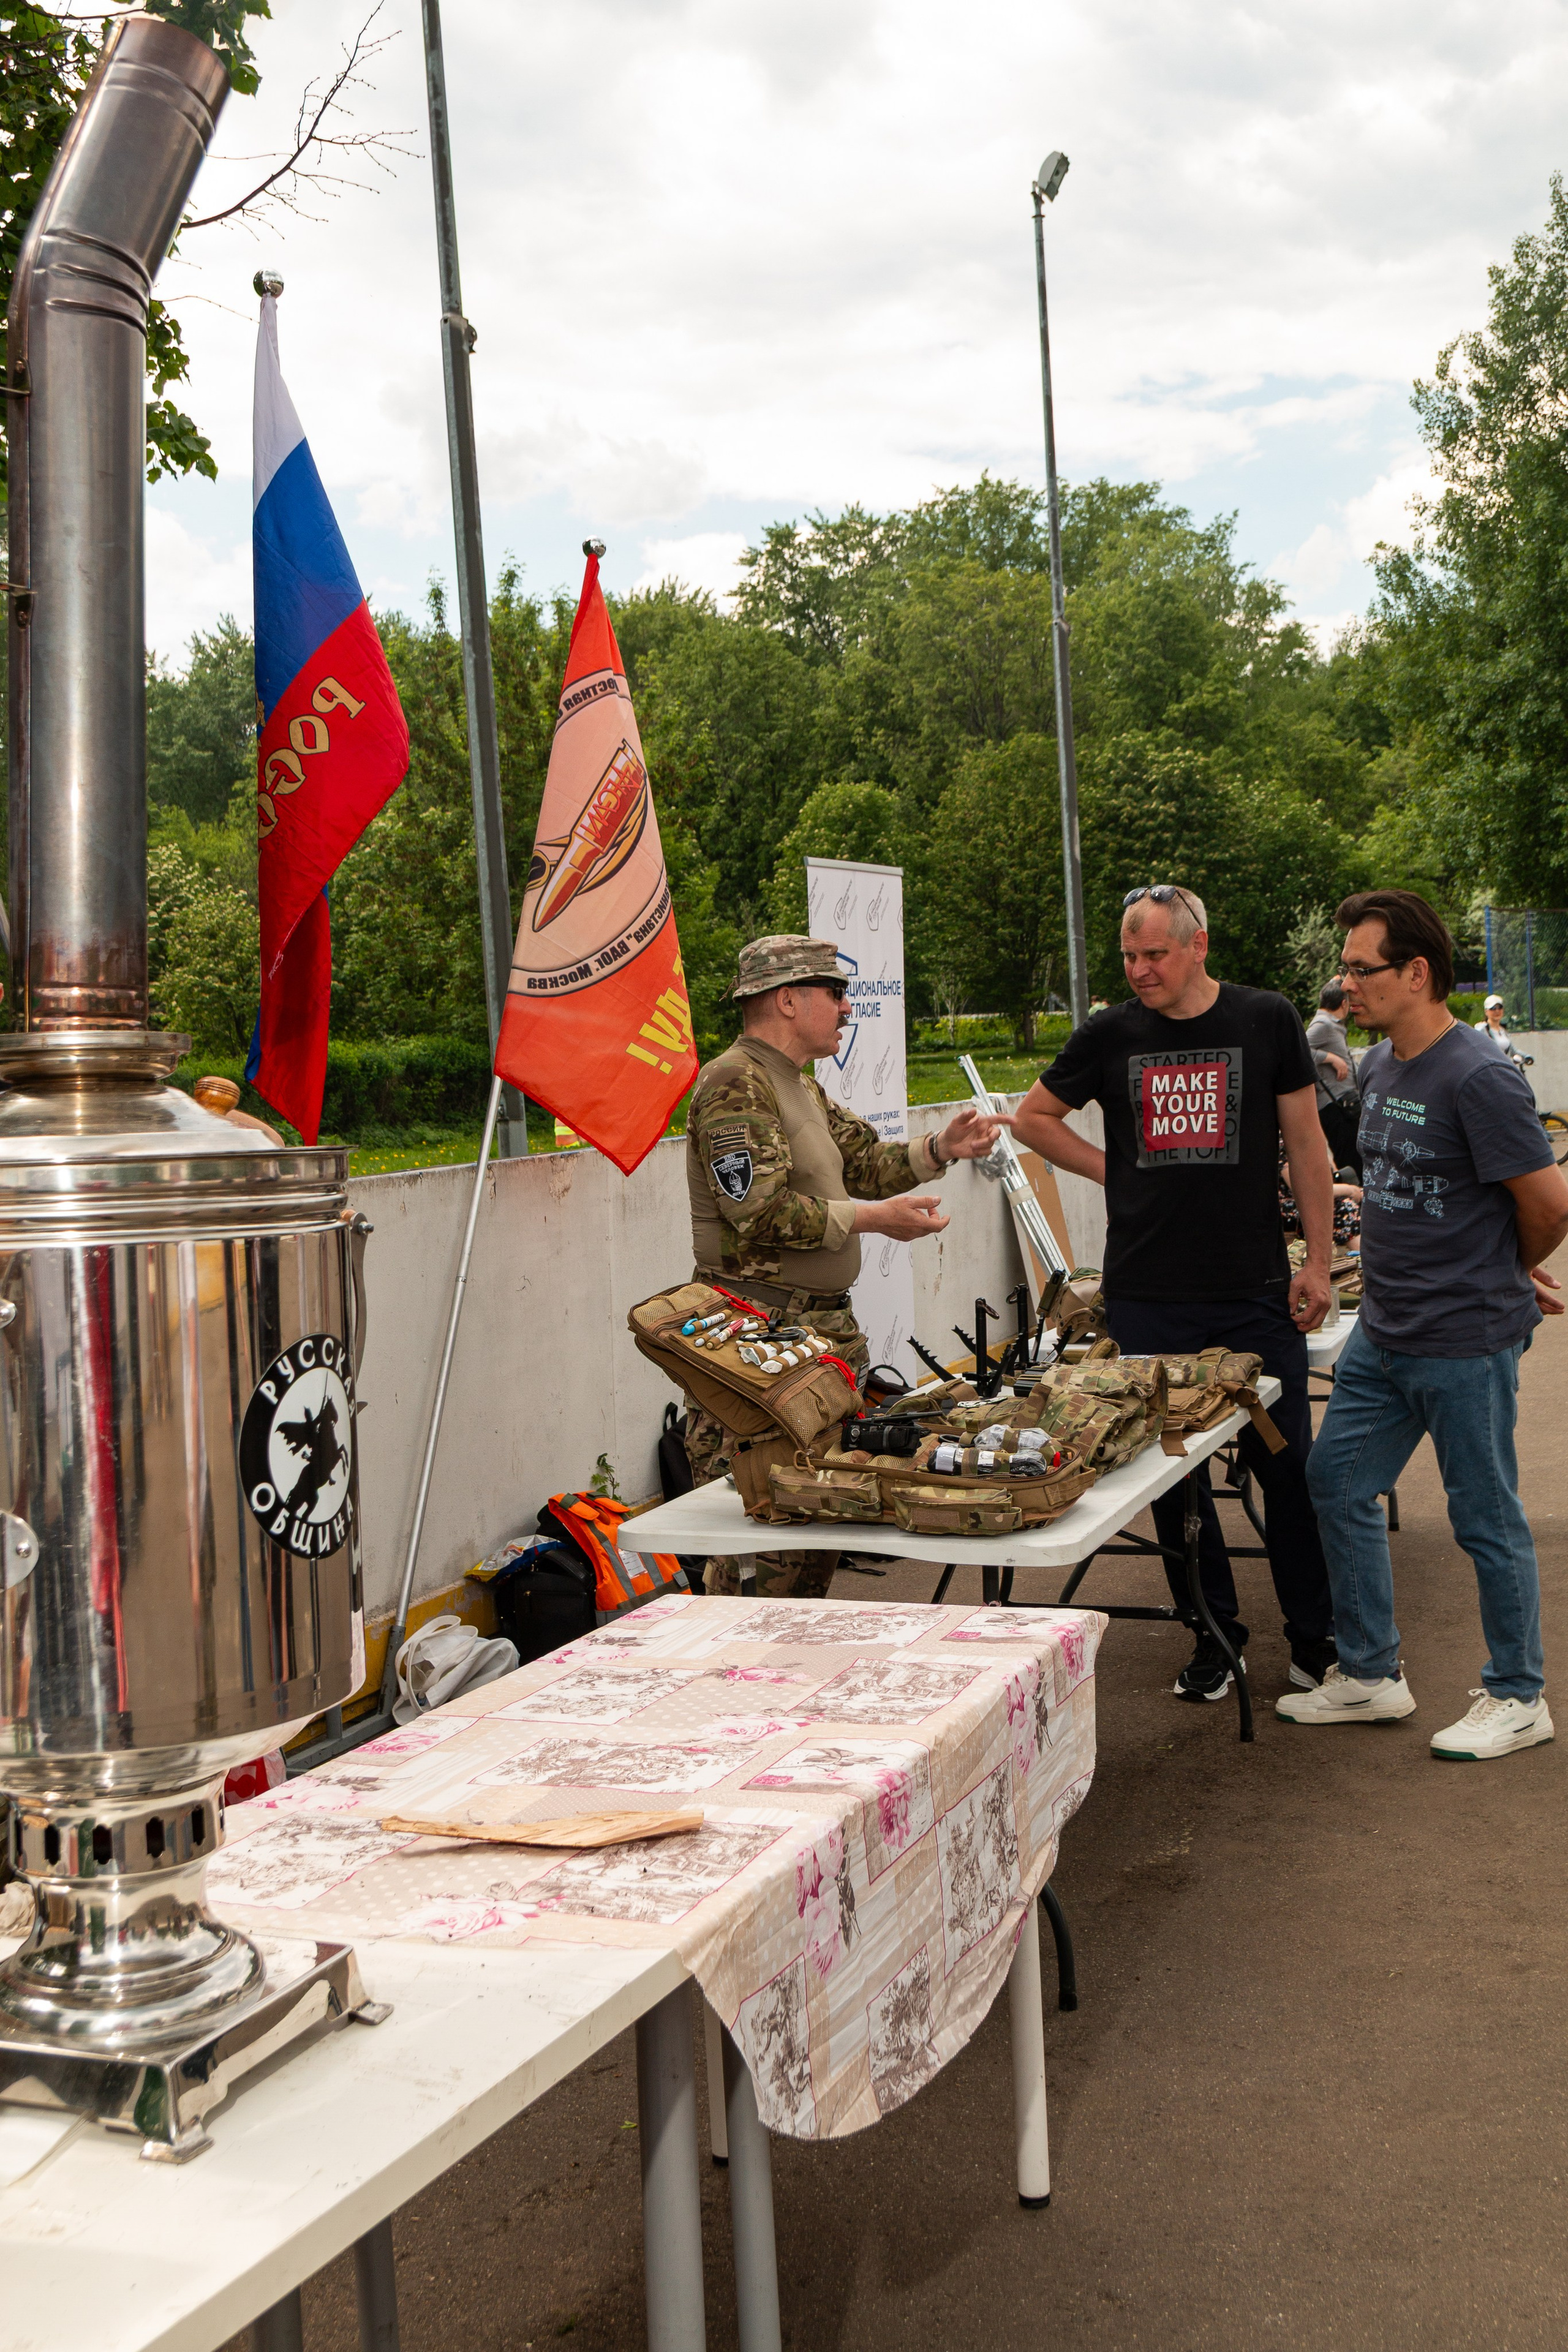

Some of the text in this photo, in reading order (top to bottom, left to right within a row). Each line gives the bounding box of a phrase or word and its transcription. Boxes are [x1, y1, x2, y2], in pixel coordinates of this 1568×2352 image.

[845, 980, 902, 1000] АЦИОНАЛЬНОЕ
[846, 1001, 881, 1019] ГЛАСИЕ
[1151, 1071, 1218, 1093] MAKE
[1151, 1092, 1217, 1115] YOUR
[1386, 1096, 1426, 1114] WELCOME
[867, 1112, 883, 1122] наших
[1152, 1113, 1218, 1137] MOVE
[1382, 1107, 1426, 1126] TO FUTURE
[710, 1125, 745, 1135] РОССИЯ
[884, 1125, 904, 1136] Защита
[718, 1159, 745, 1171] СЕВЕРНЫЙ
[722, 1164, 744, 1174] ЧЕЛОВЕК
[258, 1337, 355, 1419] РУССКАЯ
[251, 1482, 354, 1555] ОБЩИНА
